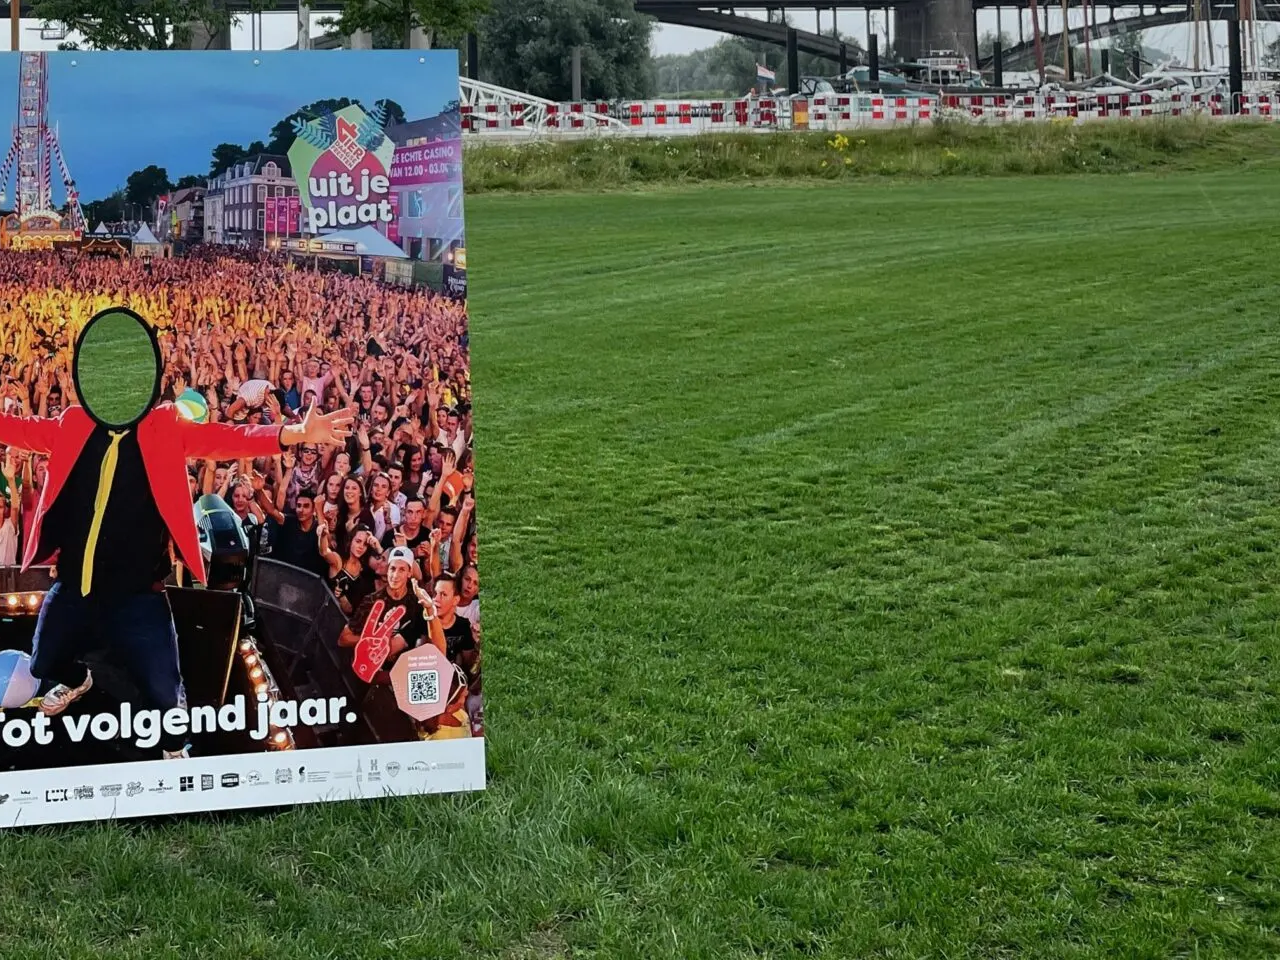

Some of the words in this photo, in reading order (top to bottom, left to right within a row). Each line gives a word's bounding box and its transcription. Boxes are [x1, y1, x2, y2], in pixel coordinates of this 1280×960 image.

[401, 149, 423, 163] ECHTE
[424, 146, 454, 160] CASINO
[404, 164, 423, 177] 12.00
[308, 171, 355, 197] uit
[355, 168, 390, 202] je
[308, 199, 393, 234] plaat
[62, 694, 246, 748] volgend
[249, 691, 358, 740] jaar.
